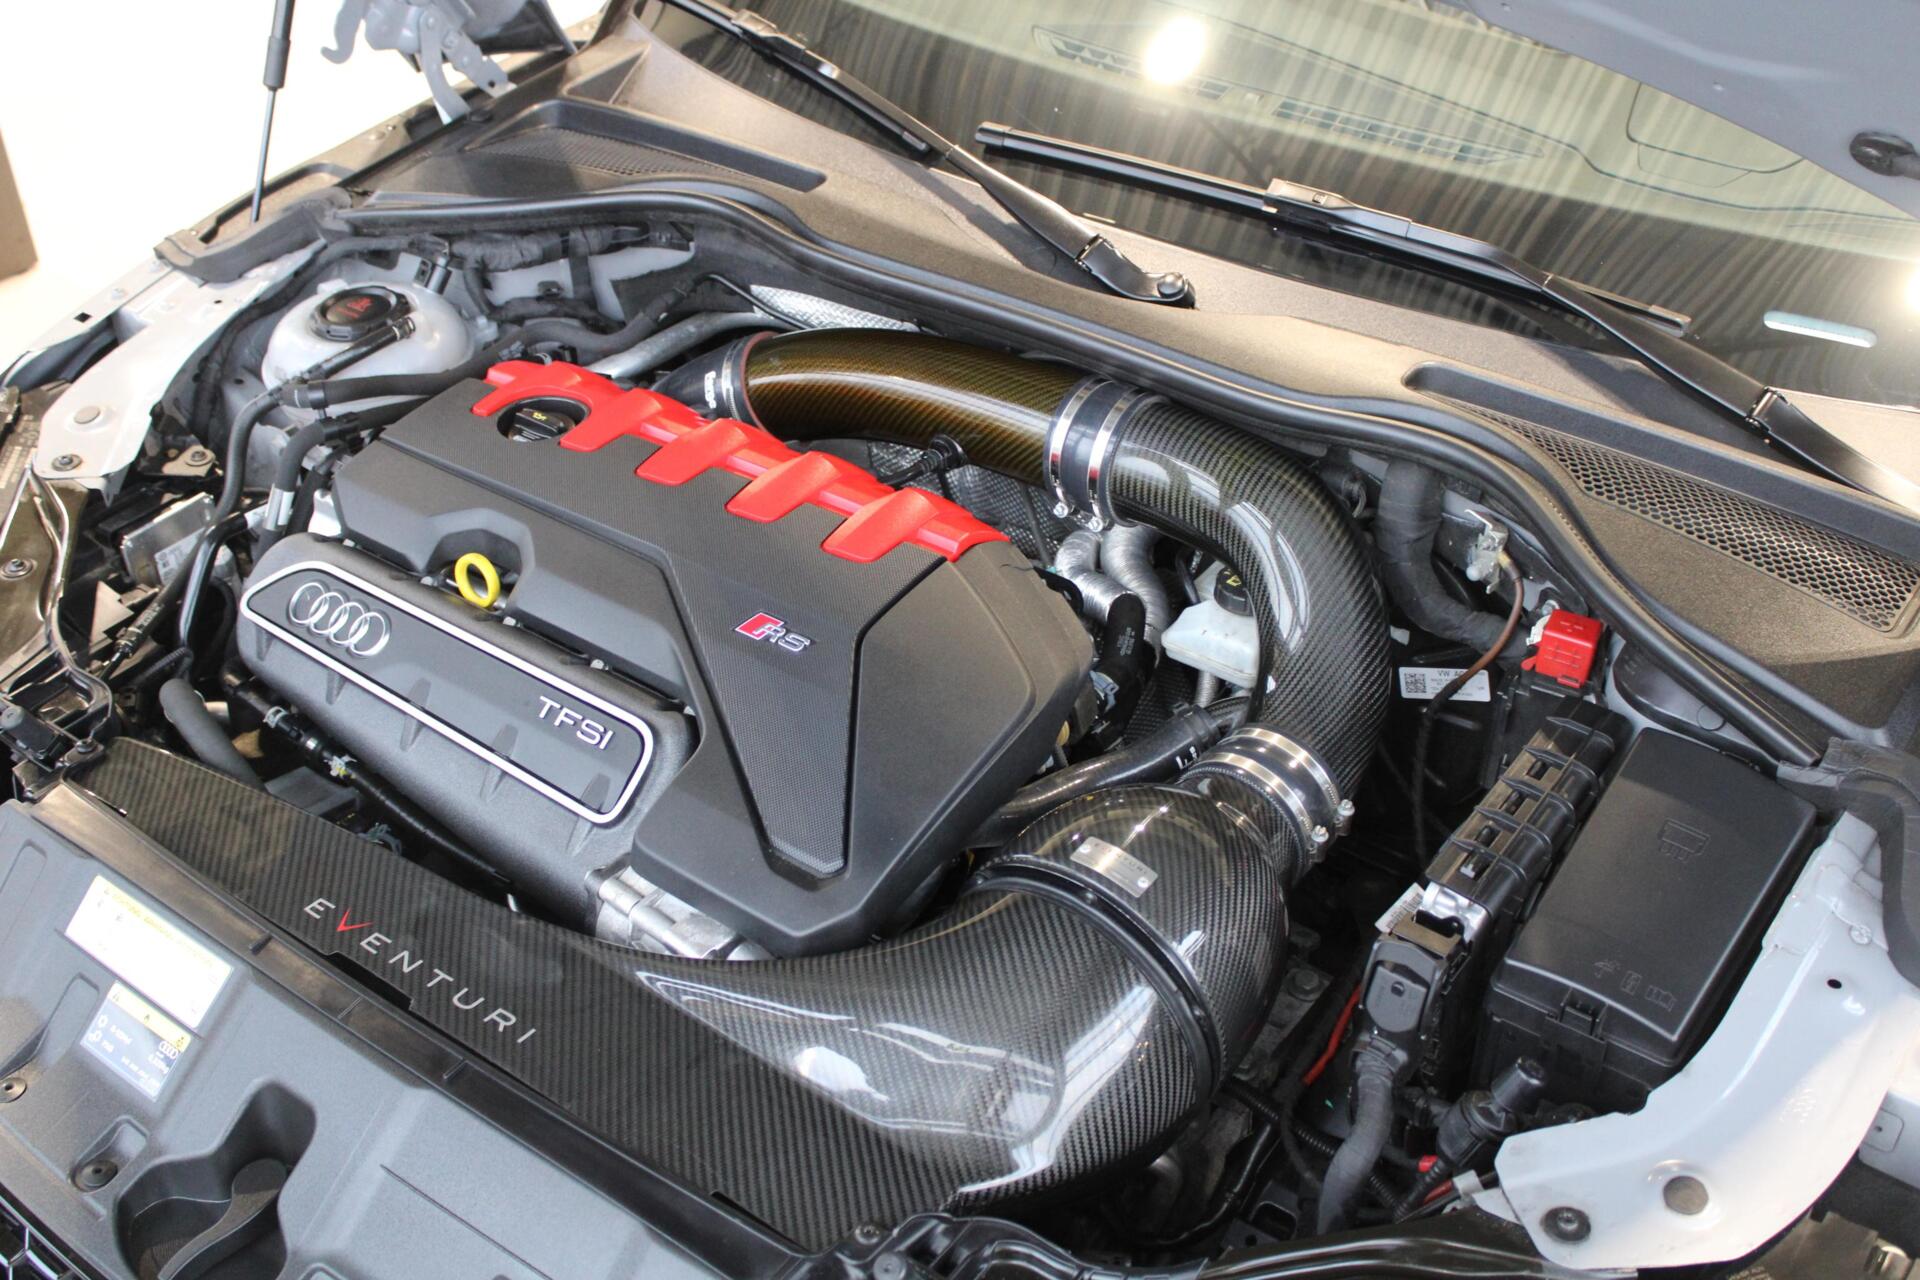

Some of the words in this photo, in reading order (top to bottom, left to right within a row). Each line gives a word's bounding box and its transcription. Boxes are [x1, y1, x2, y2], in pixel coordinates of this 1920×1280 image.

[748, 620, 811, 652] RS
[539, 695, 615, 750] TFSI
[303, 897, 537, 1044] EVENTURI
